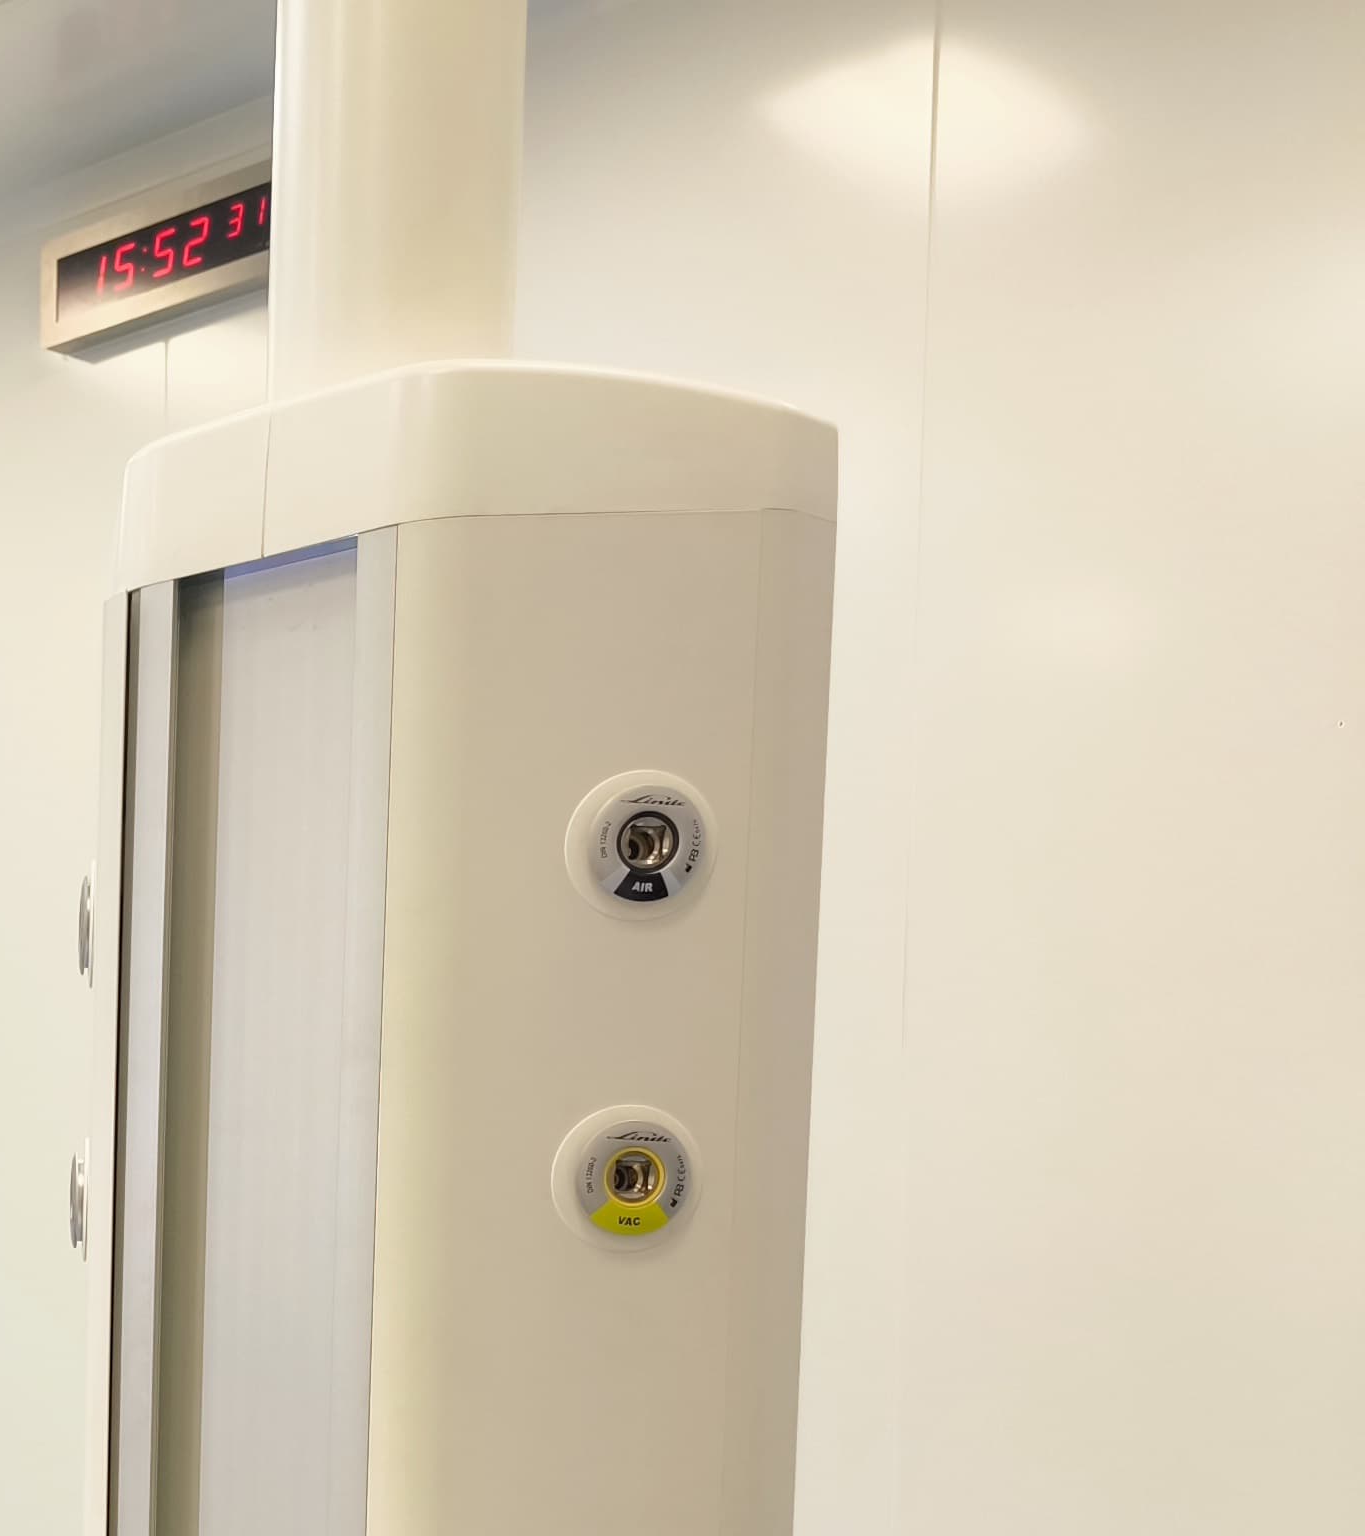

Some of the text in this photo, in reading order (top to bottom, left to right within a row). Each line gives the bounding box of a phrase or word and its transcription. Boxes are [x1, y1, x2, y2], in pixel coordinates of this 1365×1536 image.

[95, 215, 212, 297] 15:52
[631, 881, 653, 892] AIR
[618, 1216, 641, 1227] VAC
